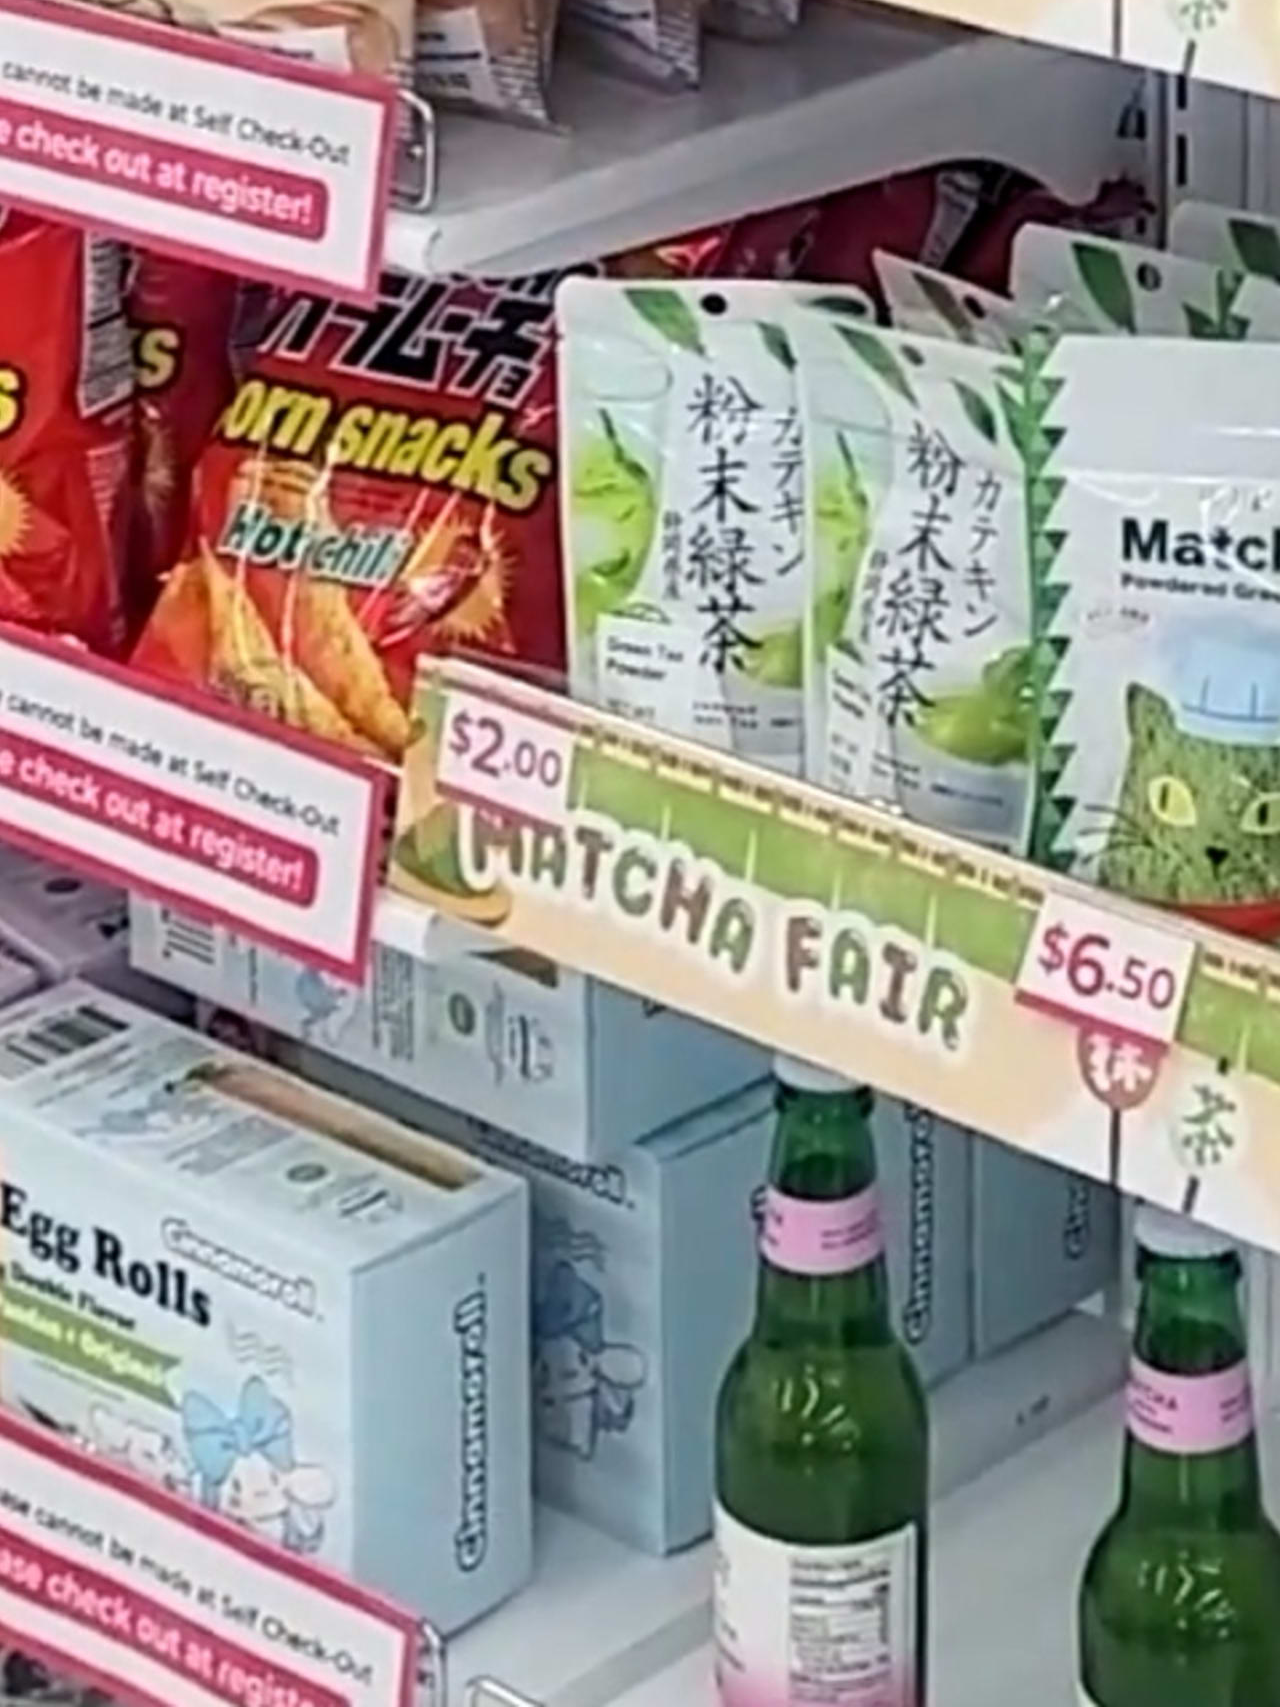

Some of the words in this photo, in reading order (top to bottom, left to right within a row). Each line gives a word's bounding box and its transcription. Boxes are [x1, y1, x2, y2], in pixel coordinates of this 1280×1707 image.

[1, 57, 70, 93] cannot
[77, 78, 103, 104] be
[107, 86, 162, 117] made
[167, 103, 189, 125] at
[192, 105, 233, 138] Self
[237, 115, 350, 168] Check-Out
[16, 114, 100, 170] check
[104, 146, 152, 182] out
[157, 157, 186, 192] at
[191, 168, 314, 227] register!
[225, 382, 327, 458] orn
[331, 395, 555, 515] snacks
[220, 504, 306, 571] Hot
[448, 709, 563, 790] $2.00
[19, 750, 99, 812] check
[106, 791, 151, 830] out
[156, 808, 185, 845] at
[190, 824, 304, 894] register!
[474, 811, 756, 977] MATCHA
[784, 913, 969, 1054] FAIR
[1037, 918, 1176, 1012] $6.50
[94, 1227, 214, 1332] Rolls
[47, 1569, 131, 1636] check
[136, 1612, 183, 1661] out
[186, 1637, 215, 1677] at
